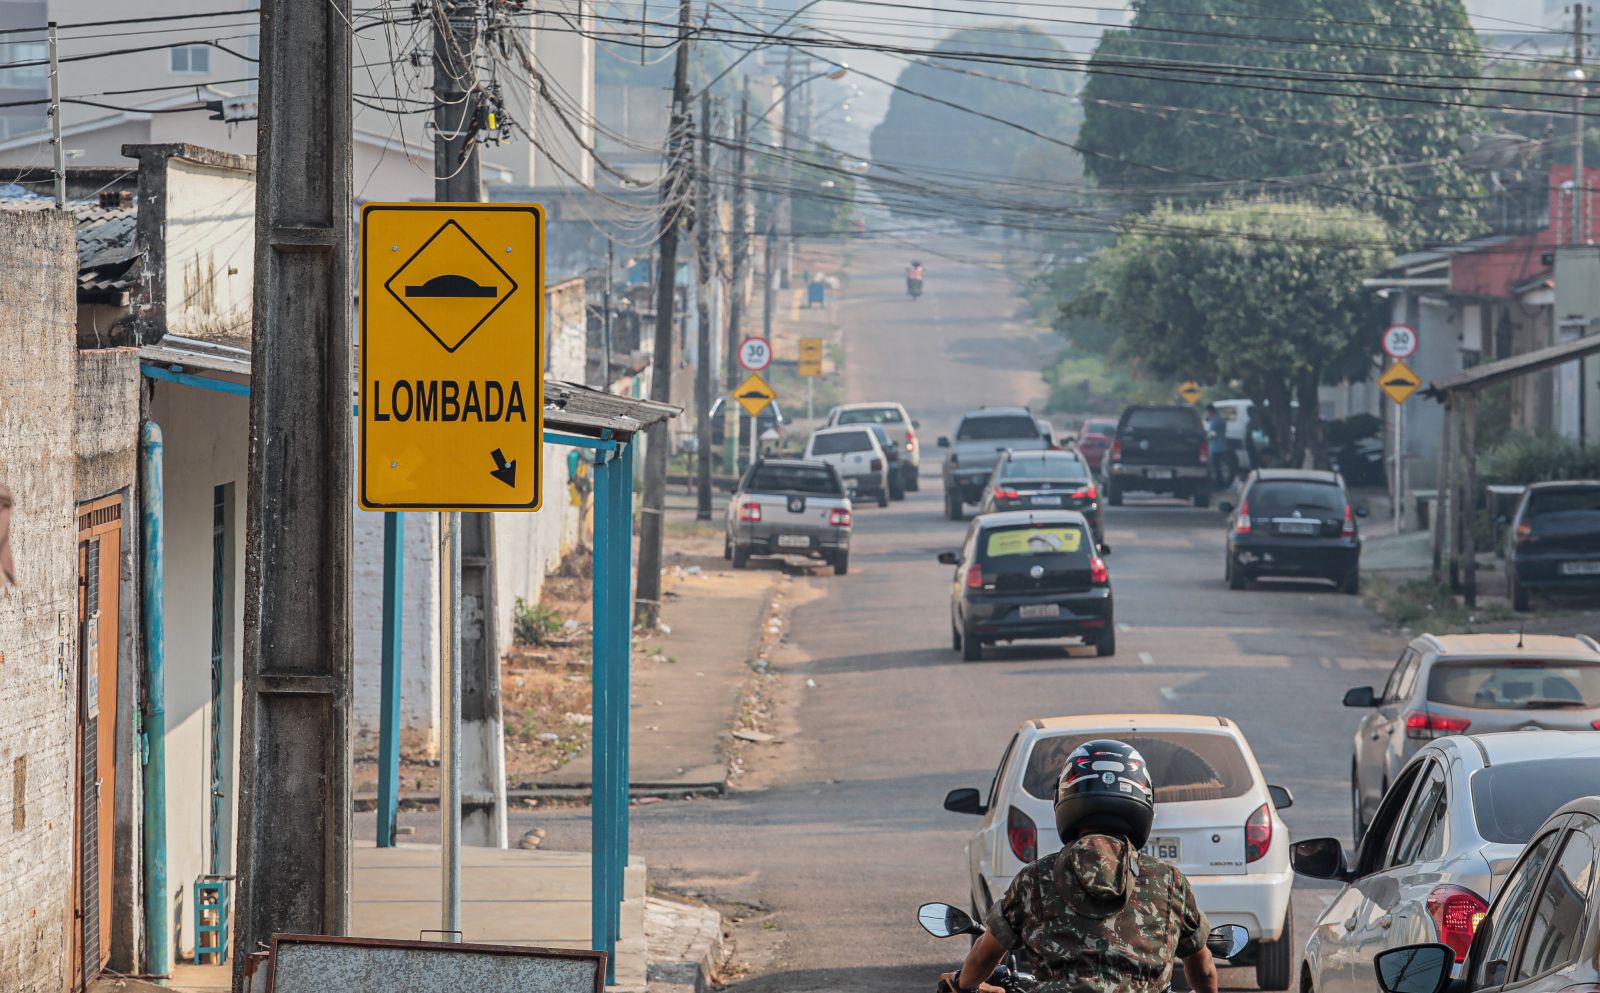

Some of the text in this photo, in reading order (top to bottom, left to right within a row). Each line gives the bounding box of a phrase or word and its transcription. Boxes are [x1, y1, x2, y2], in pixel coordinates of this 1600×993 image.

[1391, 331, 1409, 344] 30
[748, 345, 765, 357] 30
[374, 379, 527, 422] LOMBADA
